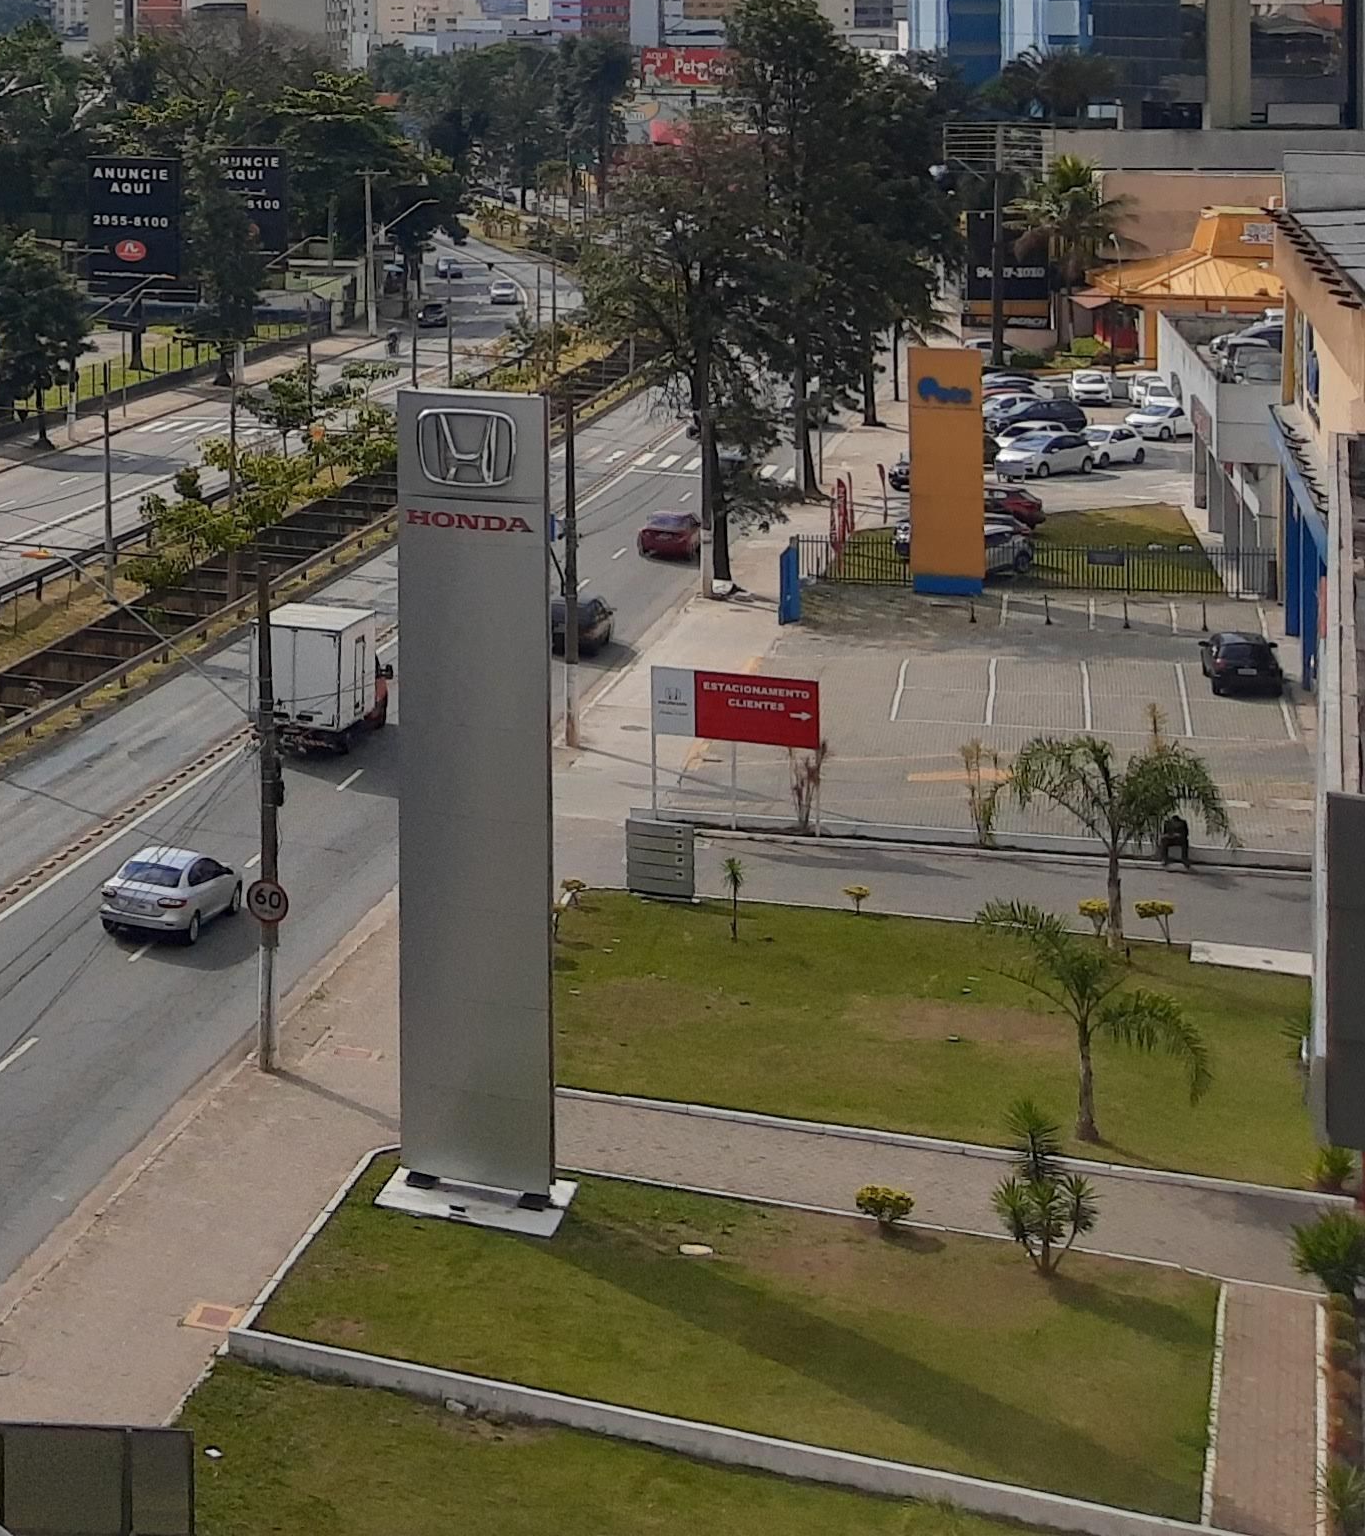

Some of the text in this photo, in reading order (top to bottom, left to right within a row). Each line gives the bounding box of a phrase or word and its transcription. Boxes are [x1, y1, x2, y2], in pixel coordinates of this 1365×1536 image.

[212, 156, 279, 168] NUNCIE
[93, 167, 169, 180] ANUNCIE
[109, 182, 151, 195] AQUI
[93, 214, 169, 228] 2955-8100
[405, 508, 534, 534] HONDA
[702, 681, 810, 700] ESTACIONAMENTO
[727, 698, 785, 712] CLIENTES
[254, 887, 282, 909] 60
